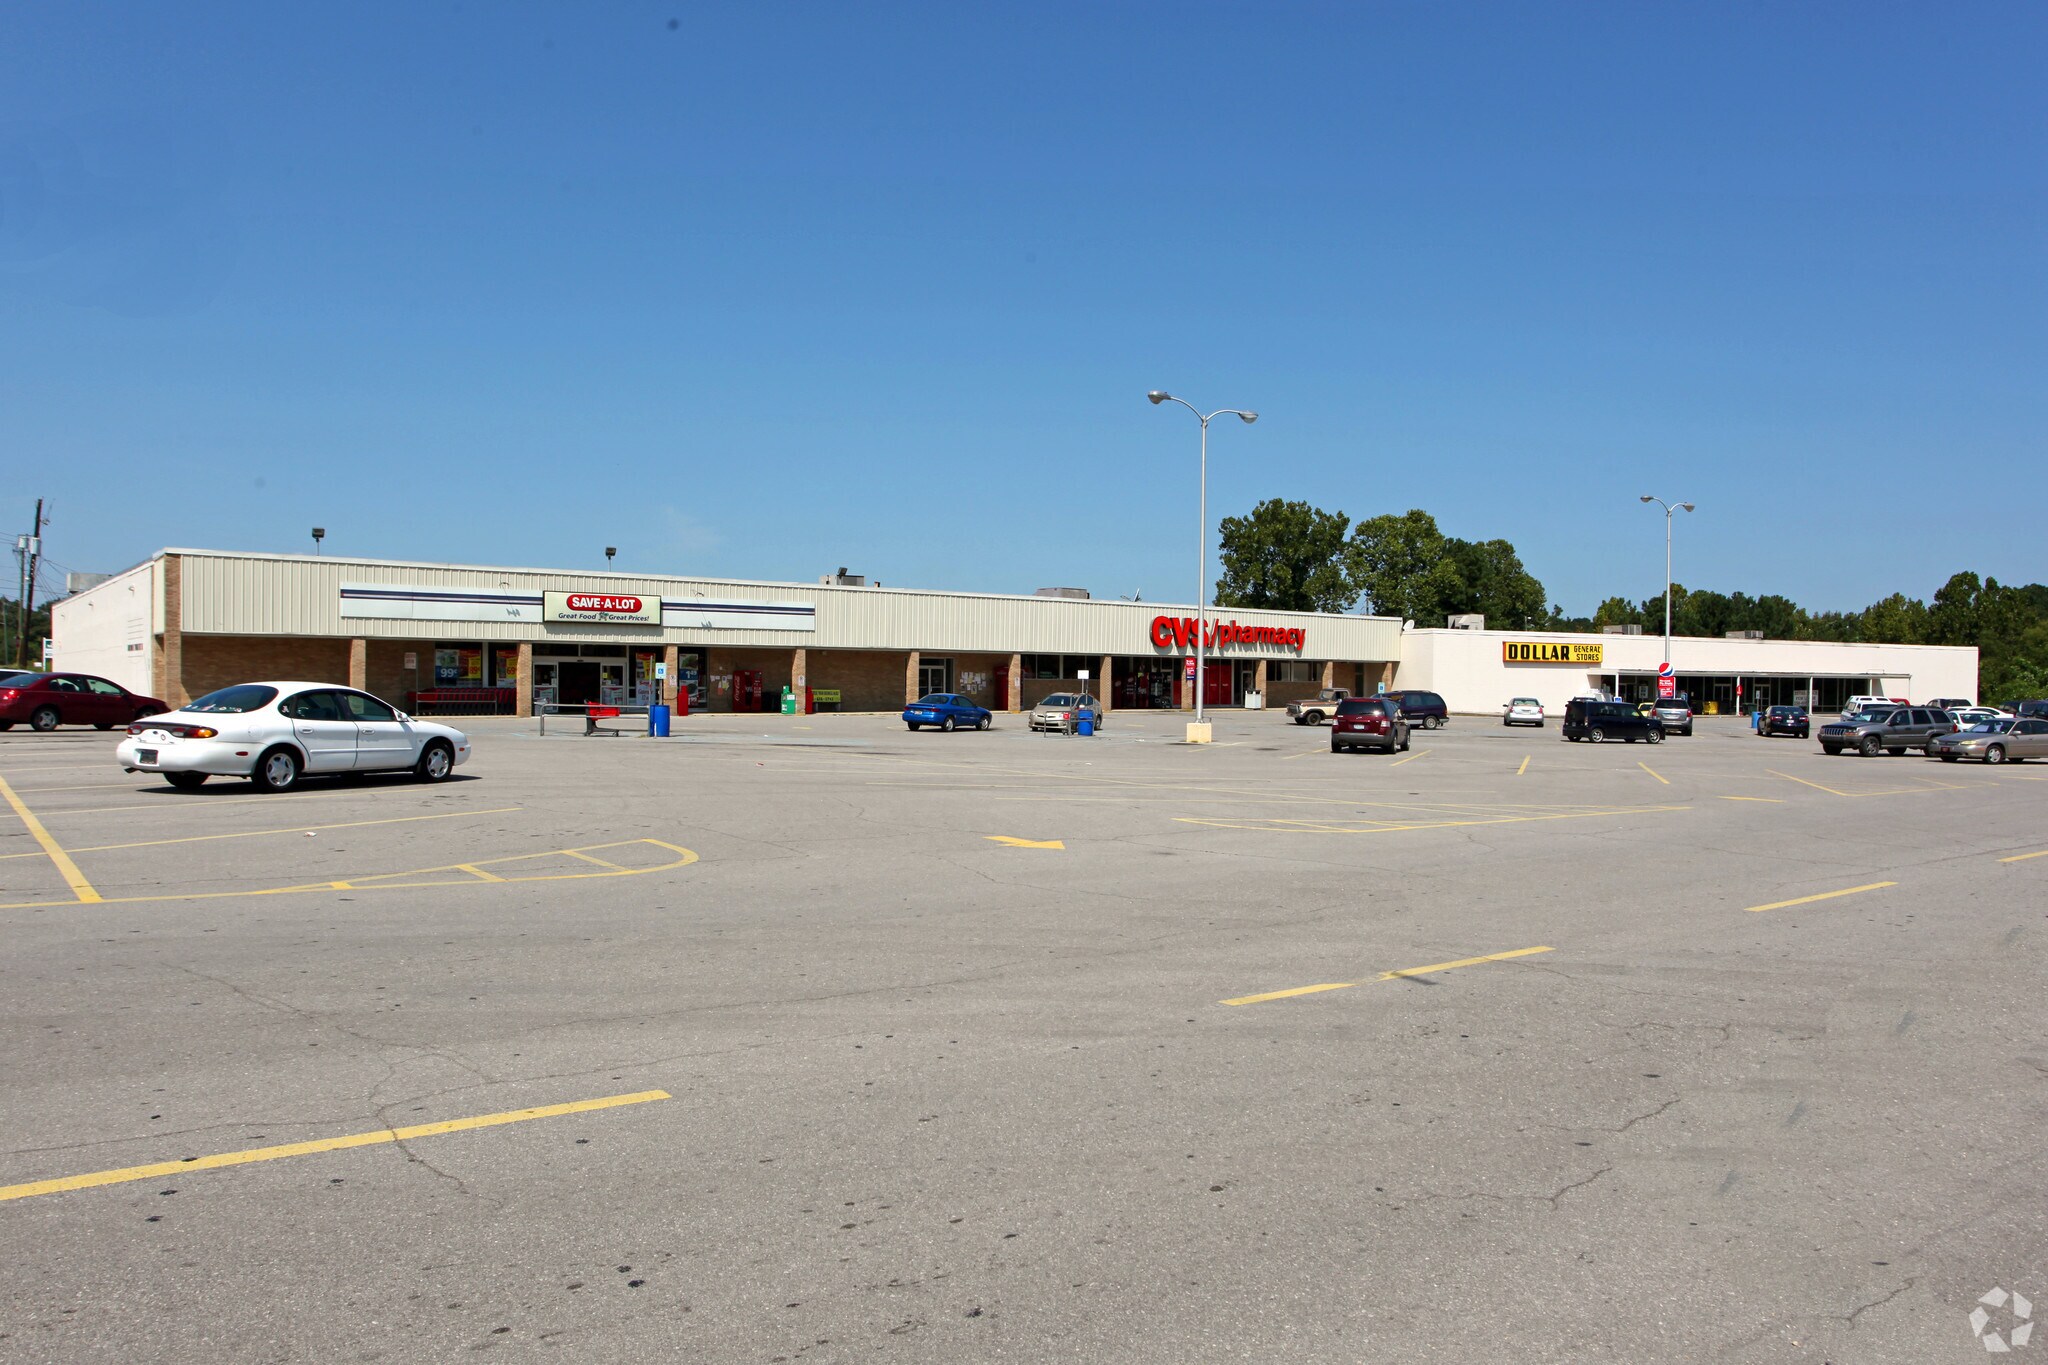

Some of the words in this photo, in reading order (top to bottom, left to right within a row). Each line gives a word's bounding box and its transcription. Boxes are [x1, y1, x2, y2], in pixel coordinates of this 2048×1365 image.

[558, 612, 577, 620] Great
[1152, 616, 1306, 650] CVS/pharmacy
[1508, 644, 1570, 660] DOLLAR
[1573, 645, 1601, 653] GENERAL
[1576, 653, 1600, 661] STORES
